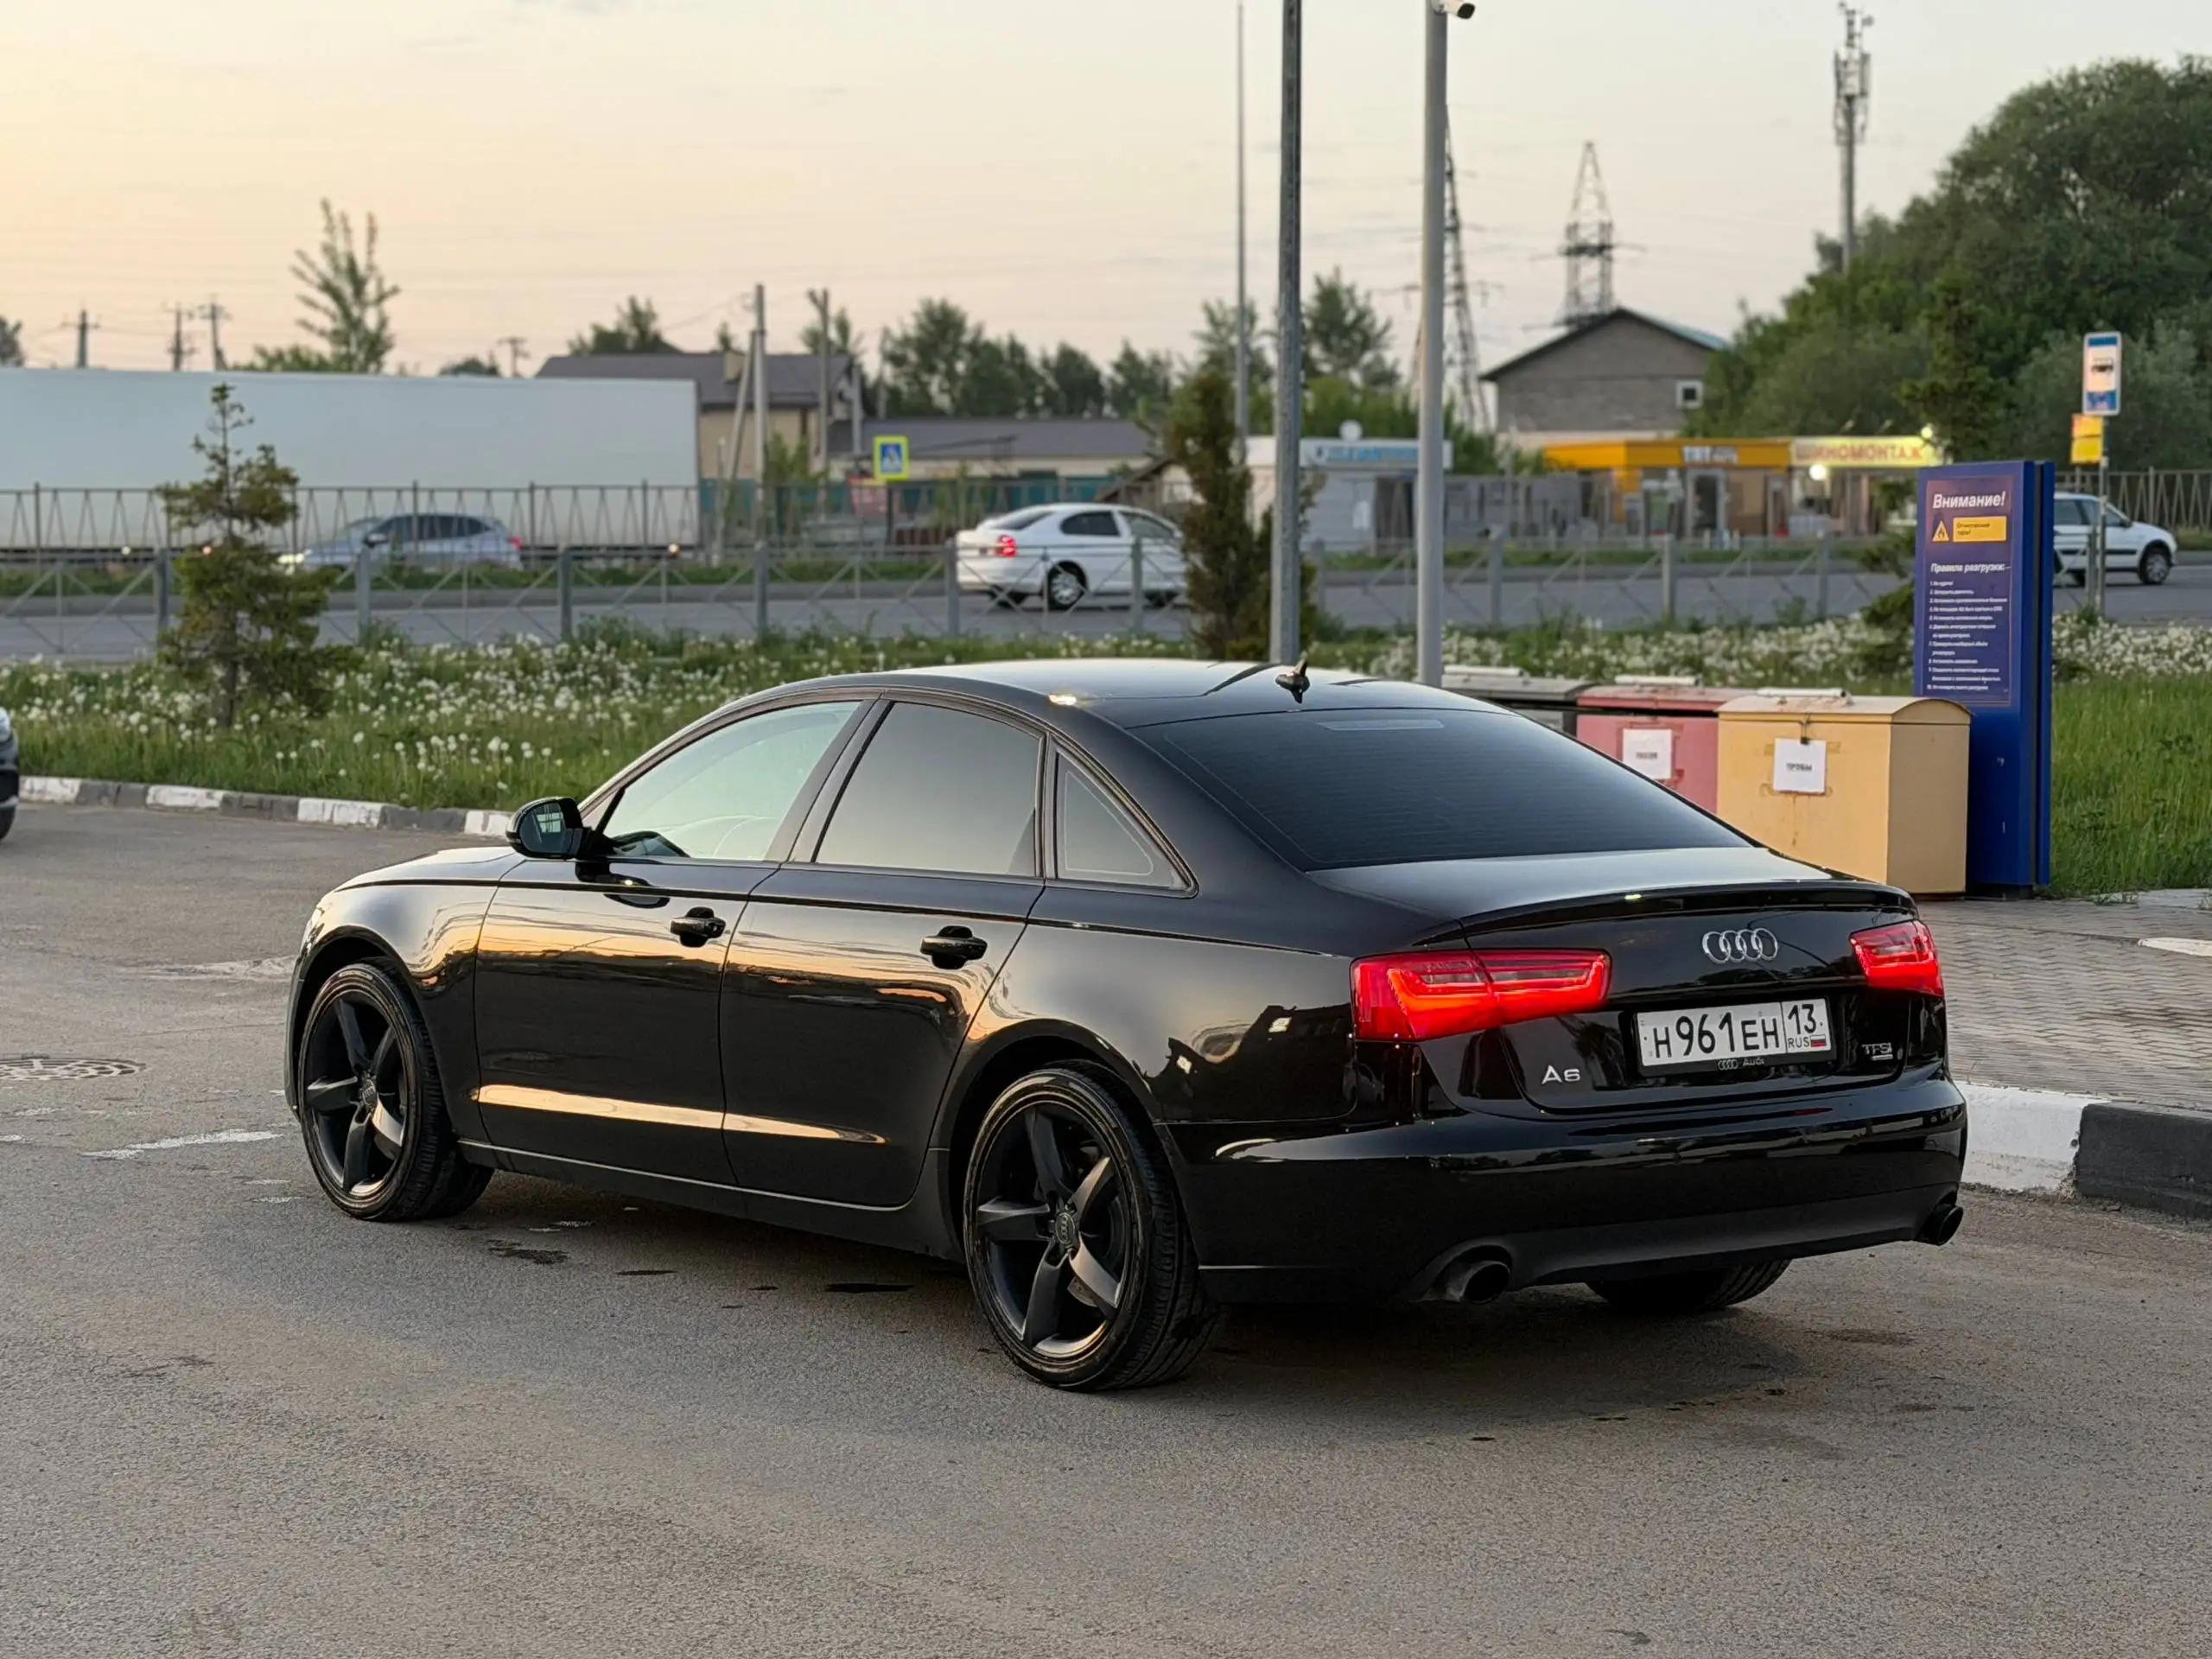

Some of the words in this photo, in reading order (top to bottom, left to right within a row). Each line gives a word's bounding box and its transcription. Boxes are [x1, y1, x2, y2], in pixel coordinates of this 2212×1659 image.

[1932, 490, 2006, 509] Внимание!
[1788, 1003, 1816, 1034] 13
[1788, 1036, 1810, 1048] RUS
[1742, 1057, 1764, 1067] Audi
[1541, 1065, 1580, 1084] A6
